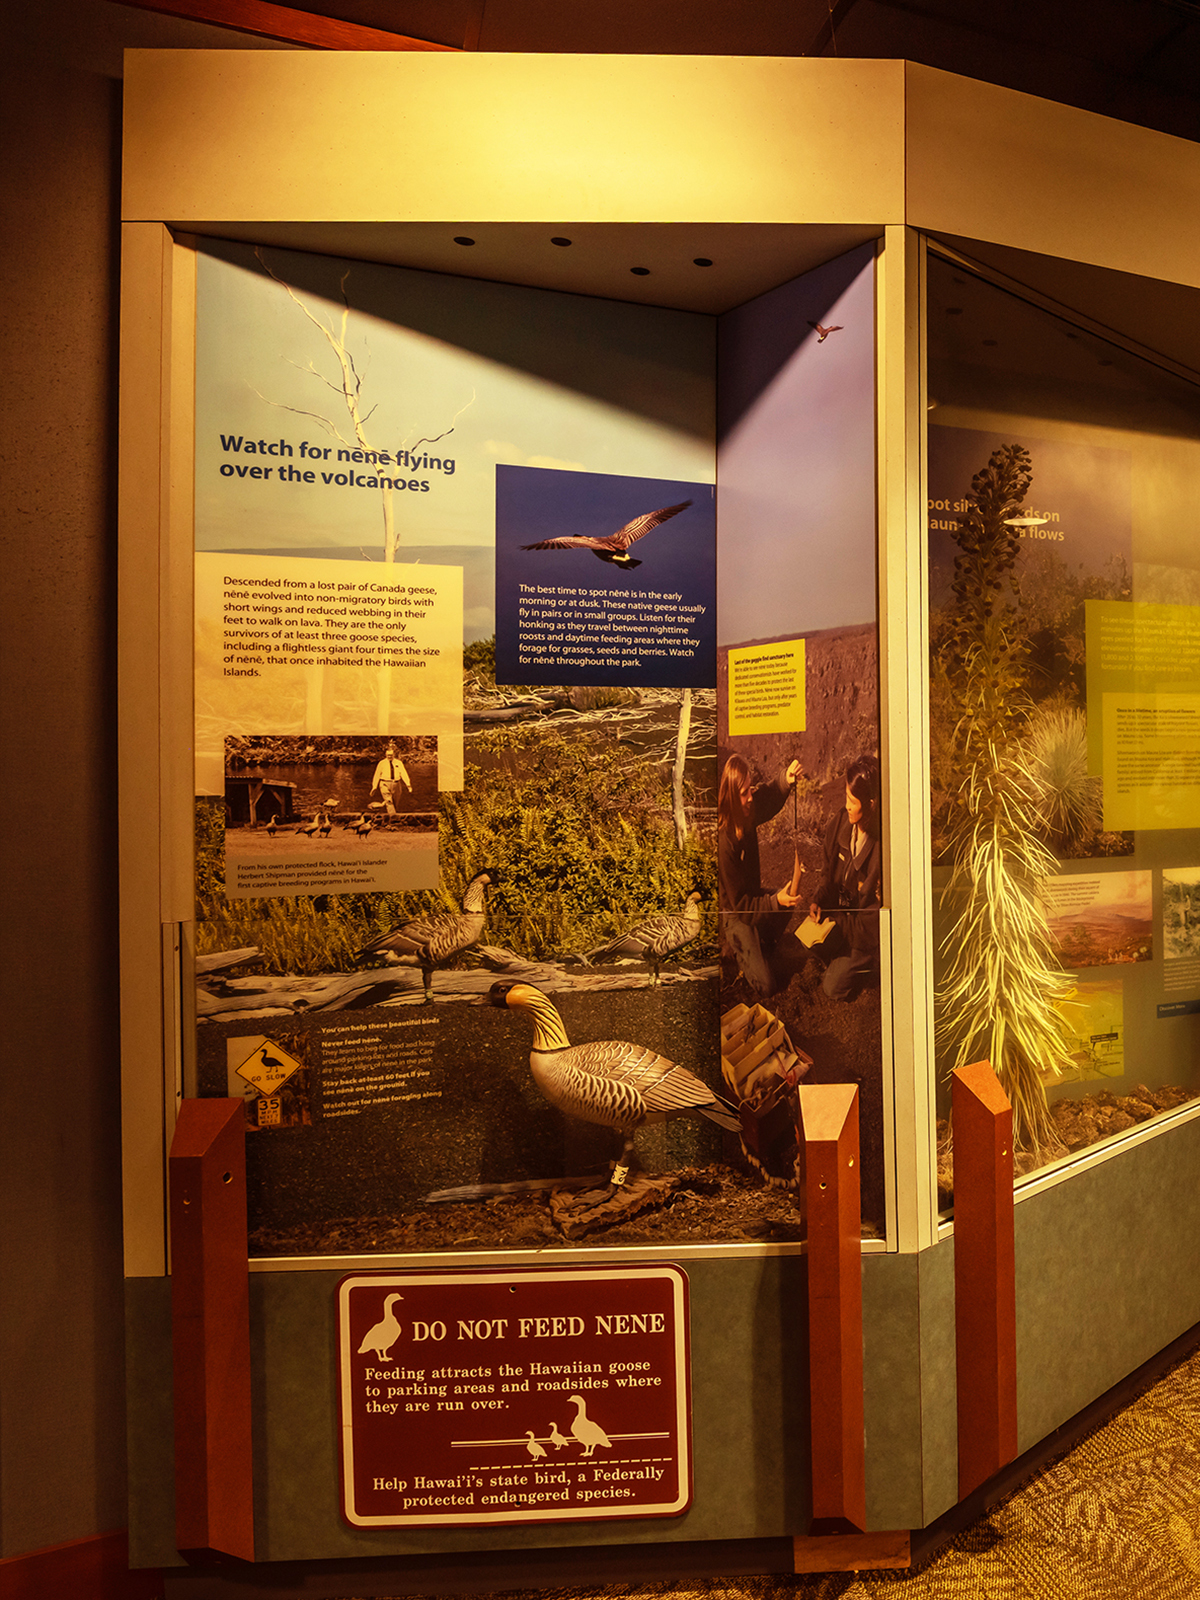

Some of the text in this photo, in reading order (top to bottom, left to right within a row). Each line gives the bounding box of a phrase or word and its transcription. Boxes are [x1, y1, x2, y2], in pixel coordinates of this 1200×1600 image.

[220, 434, 293, 457] Watch
[299, 441, 332, 460] for
[395, 450, 455, 475] flying
[220, 464, 430, 492] over the volcanoes
[928, 498, 951, 511] pot
[1043, 511, 1060, 522] on
[1029, 525, 1065, 541] flows
[224, 576, 281, 587] Descended
[283, 579, 307, 588] from
[318, 581, 335, 590] lost
[338, 583, 356, 592] pair
[358, 582, 369, 591] of
[370, 583, 406, 593] Canada
[407, 587, 437, 595] geese,
[519, 584, 536, 593] The
[537, 585, 556, 594] best
[557, 586, 577, 595] time
[589, 589, 607, 598] spot
[631, 590, 638, 598] is
[639, 590, 647, 598] in
[648, 591, 662, 599] the
[663, 592, 682, 602] early
[251, 591, 292, 601] evolved
[294, 593, 314, 602] into
[316, 595, 386, 606] non-migratory
[388, 597, 412, 606] birds
[413, 598, 434, 606] with
[519, 598, 556, 608] morning
[578, 600, 601, 608] dusk.
[602, 600, 626, 609] These
[628, 602, 653, 610] native
[654, 604, 678, 612] geese
[679, 604, 706, 614] usually
[223, 603, 426, 619] short wings and reduced webbing in their
[223, 615, 243, 625] feet
[246, 617, 257, 625] to
[259, 617, 283, 626] walk
[300, 618, 323, 627] lava.
[325, 619, 349, 630] They
[368, 621, 384, 630] the
[385, 622, 406, 632] only
[223, 629, 269, 638] survivors
[271, 630, 282, 639] of
[296, 631, 319, 640] least
[321, 631, 347, 641] three
[349, 634, 379, 643] goose
[381, 634, 417, 643] species,
[285, 862, 318, 870] protected
[266, 1073, 286, 1081] SLOW
[259, 1098, 279, 1111] 35
[412, 1313, 665, 1341] DO NOT FEED NENE
[365, 1361, 650, 1381] Feeding attracts the Hawaiian goose
[365, 1375, 662, 1399] to parking areas and roadsides where
[366, 1400, 509, 1415] they are run over.
[374, 1478, 407, 1492] Help
[490, 1474, 528, 1487] state
[535, 1471, 571, 1486] bird,
[578, 1473, 586, 1482] a
[593, 1468, 664, 1481] Federally
[403, 1486, 636, 1509] protected endangered species.
